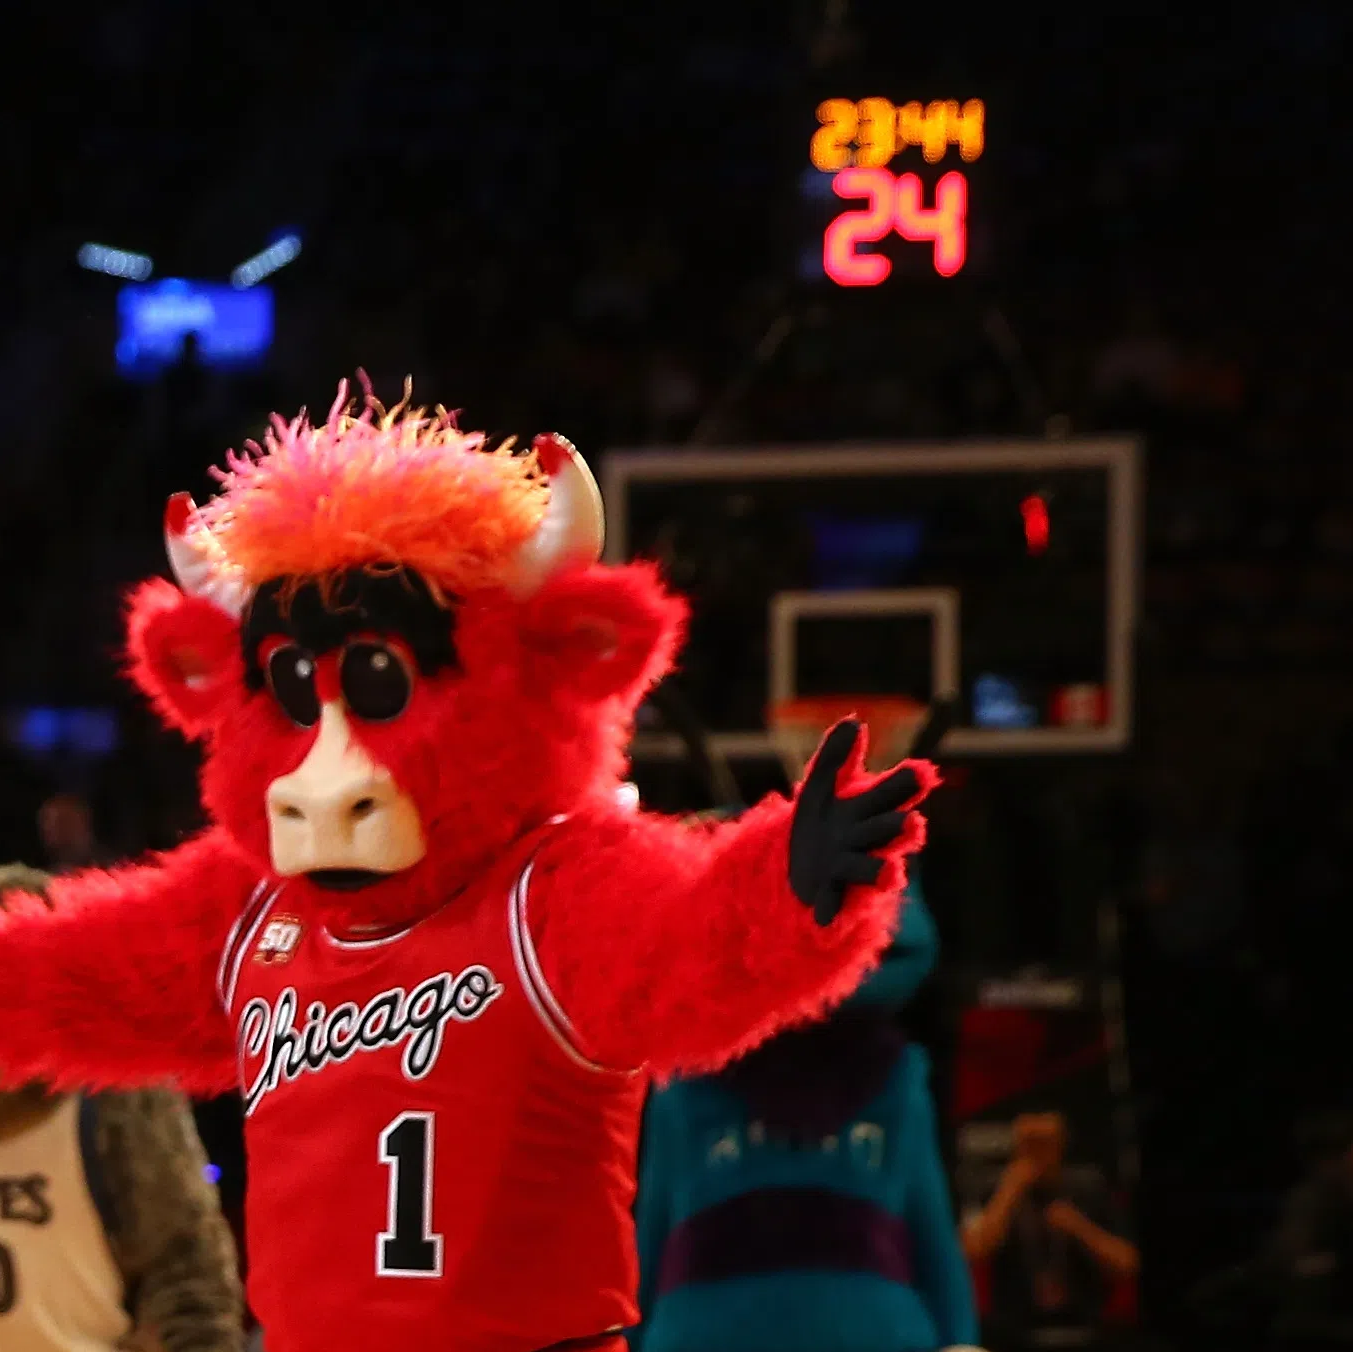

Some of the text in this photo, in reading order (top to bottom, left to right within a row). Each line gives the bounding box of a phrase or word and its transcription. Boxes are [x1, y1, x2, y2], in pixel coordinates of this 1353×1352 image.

[810, 97, 985, 172] 23:44
[823, 167, 969, 287] 24
[256, 921, 302, 953] 50
[238, 964, 504, 1117] Chicago
[376, 1110, 444, 1278] 1
